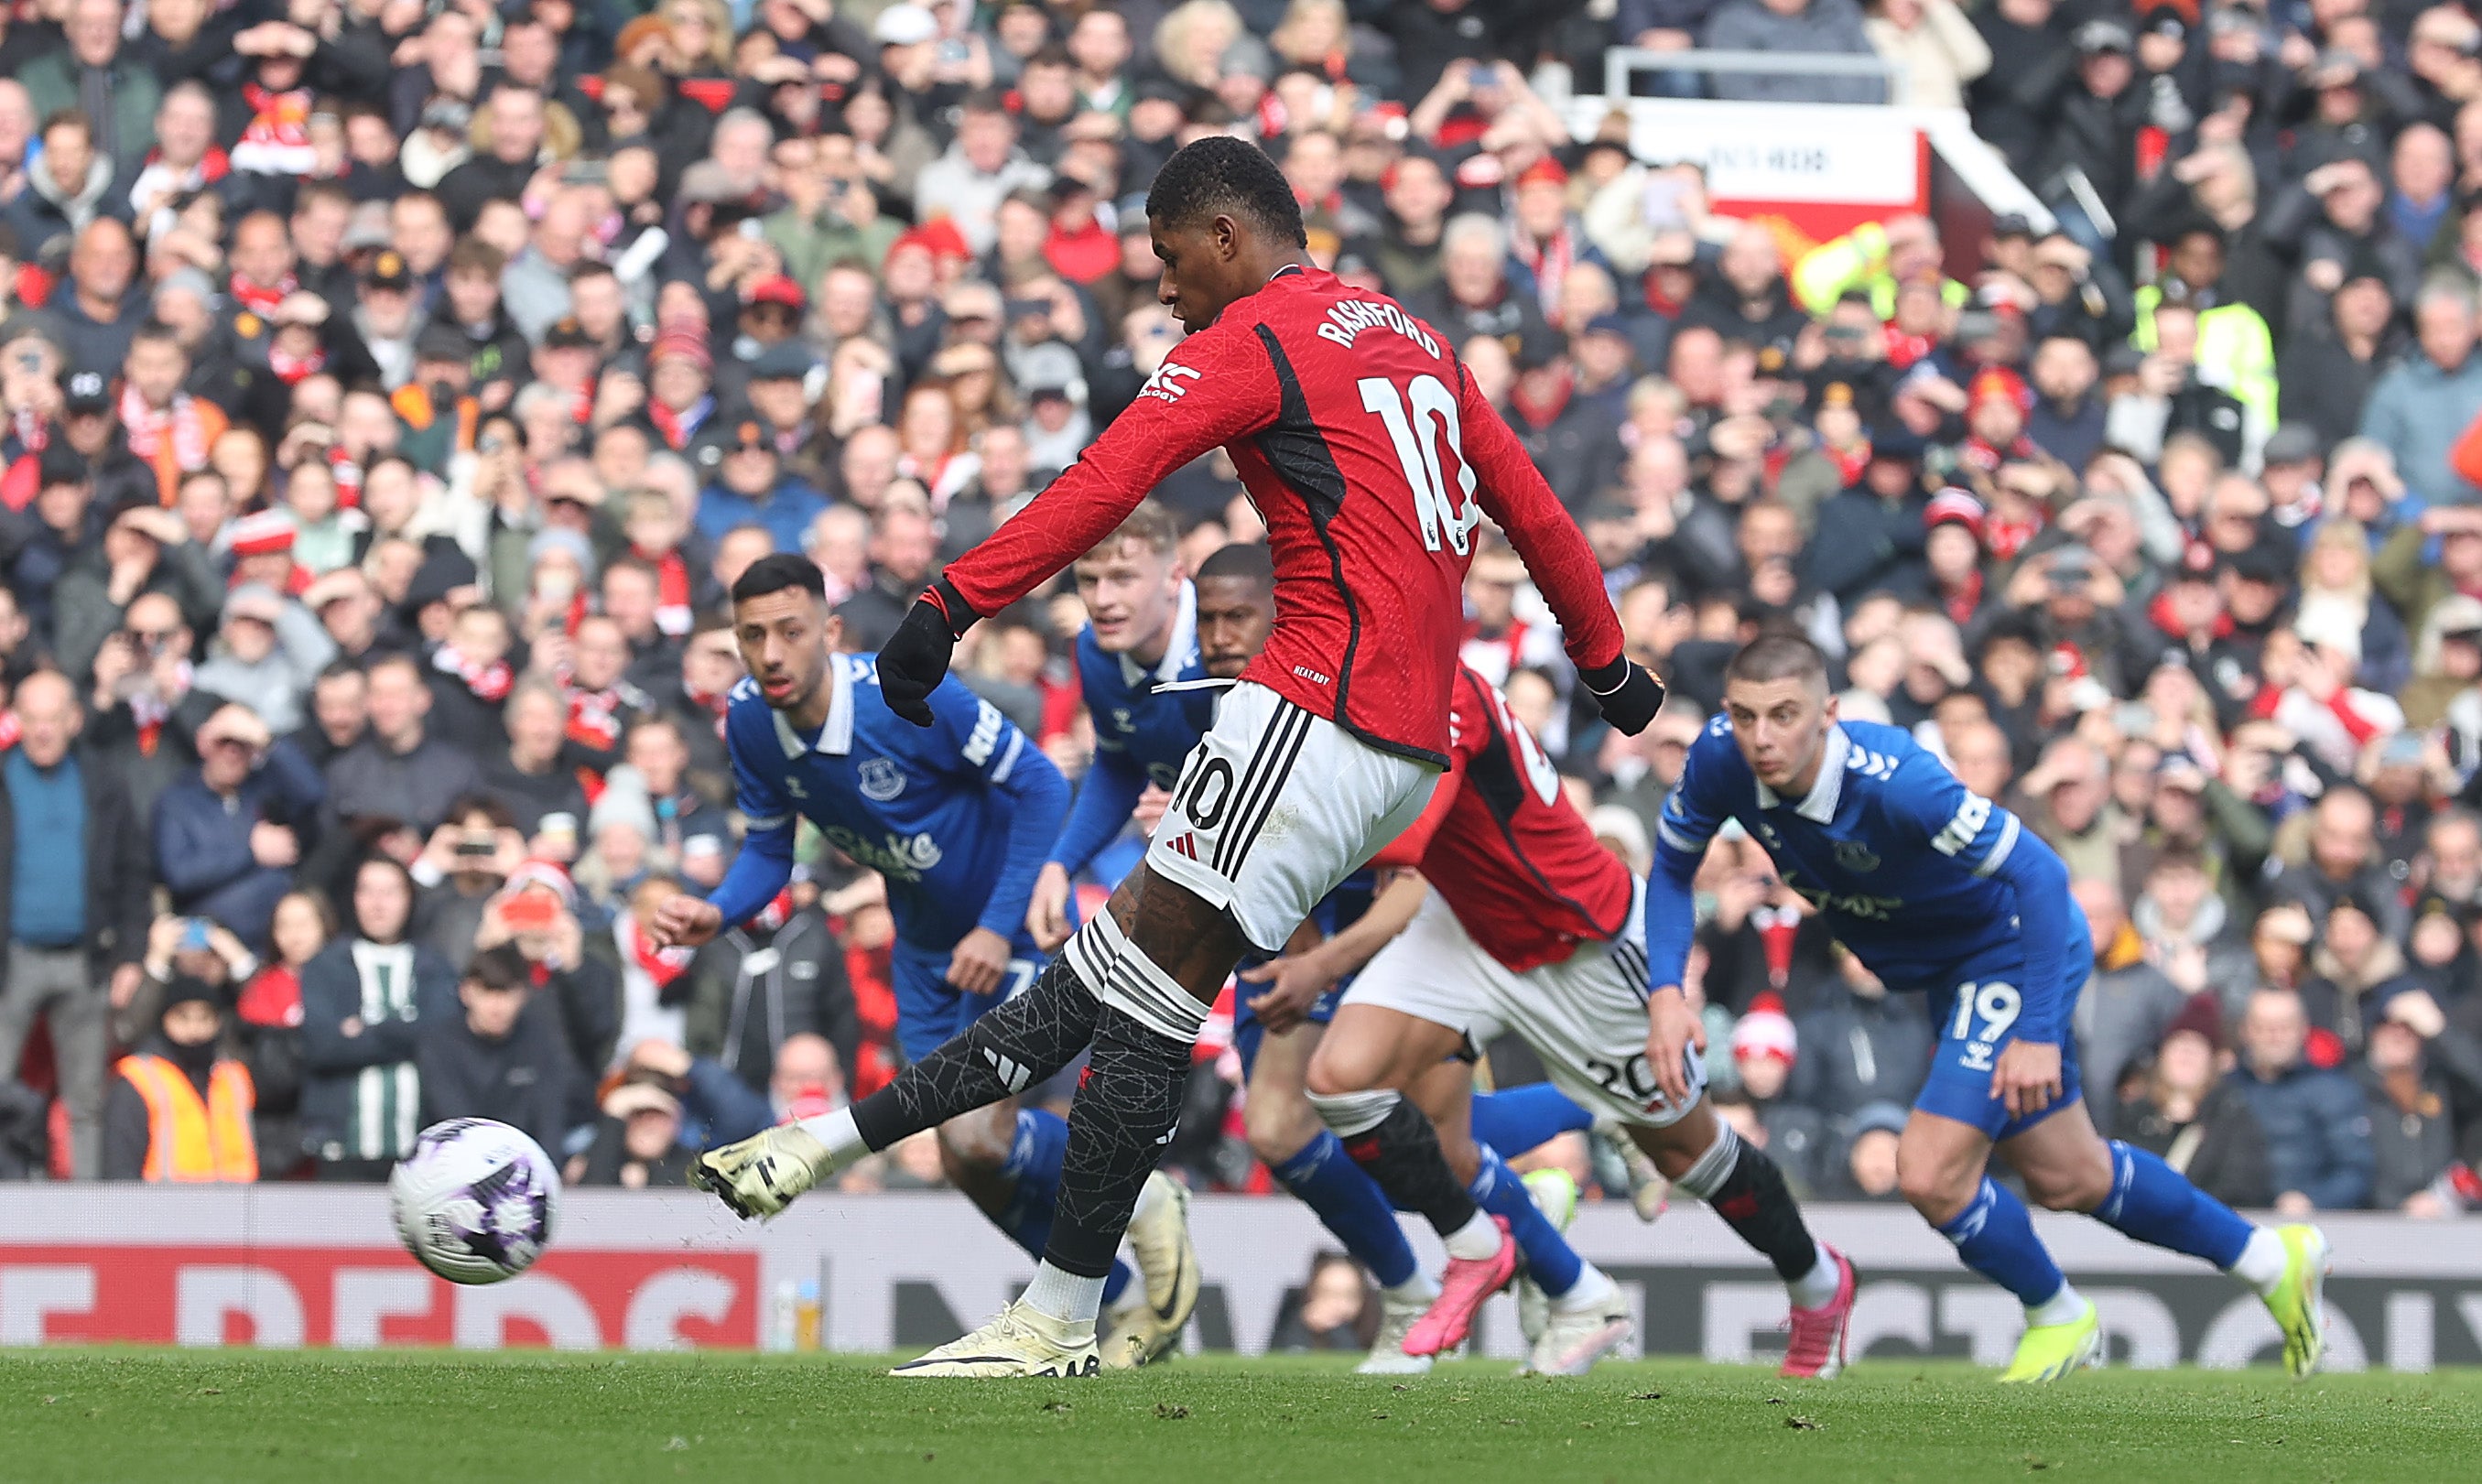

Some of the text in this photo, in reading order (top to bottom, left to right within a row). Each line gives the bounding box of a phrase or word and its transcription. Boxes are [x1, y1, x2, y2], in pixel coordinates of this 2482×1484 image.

[1317, 299, 1442, 360] RASHFORD
[1357, 374, 1479, 556] 10
[1293, 665, 1331, 686] HEAT.RDY
[1172, 742, 1235, 830] 10
[1951, 980, 2023, 1044] 19
